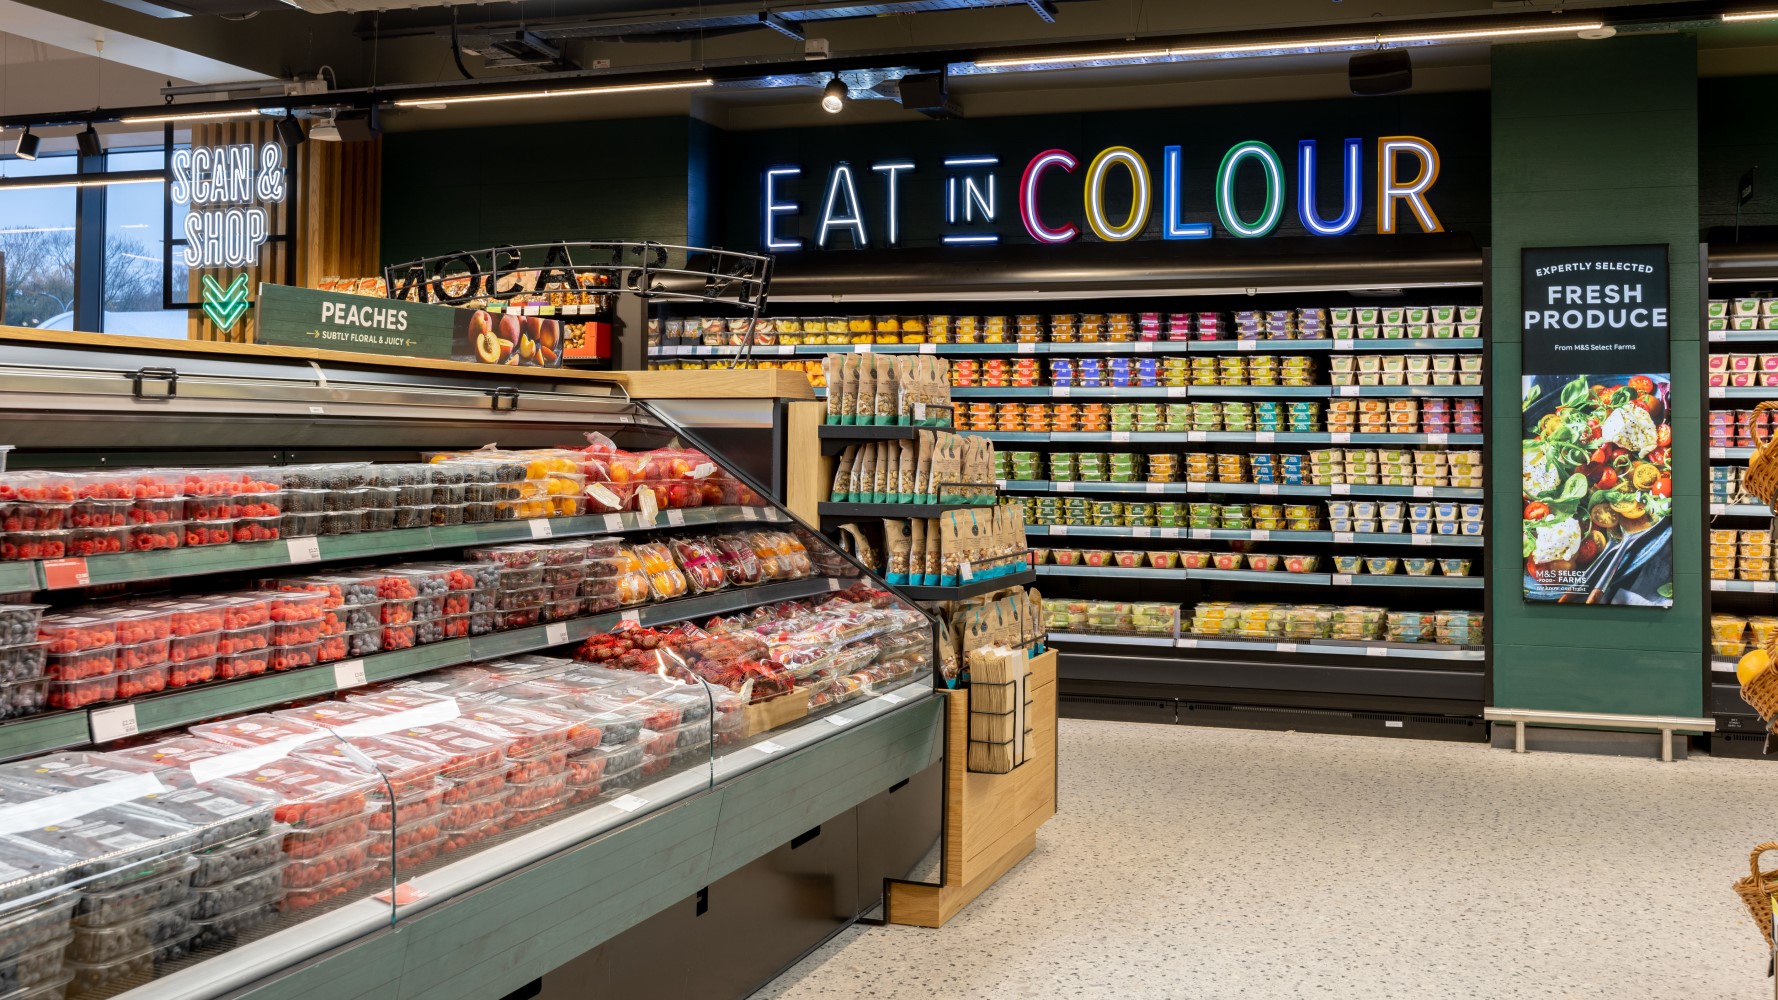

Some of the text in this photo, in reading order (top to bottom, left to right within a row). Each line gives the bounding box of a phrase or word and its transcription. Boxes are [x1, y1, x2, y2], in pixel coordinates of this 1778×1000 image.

[172, 143, 282, 204] SCAN &
[763, 135, 1446, 249] EAT IN COLOUR
[184, 209, 266, 267] SHOP
[1536, 262, 1654, 277] EXPERTLY SELECTED
[1548, 284, 1642, 304] FRESH
[321, 301, 408, 331] PEACHES
[1524, 308, 1667, 329] PRODUCE
[322, 330, 404, 346] SUBTLY FLORAL & JUICY
[1535, 570, 1557, 578] M&S
